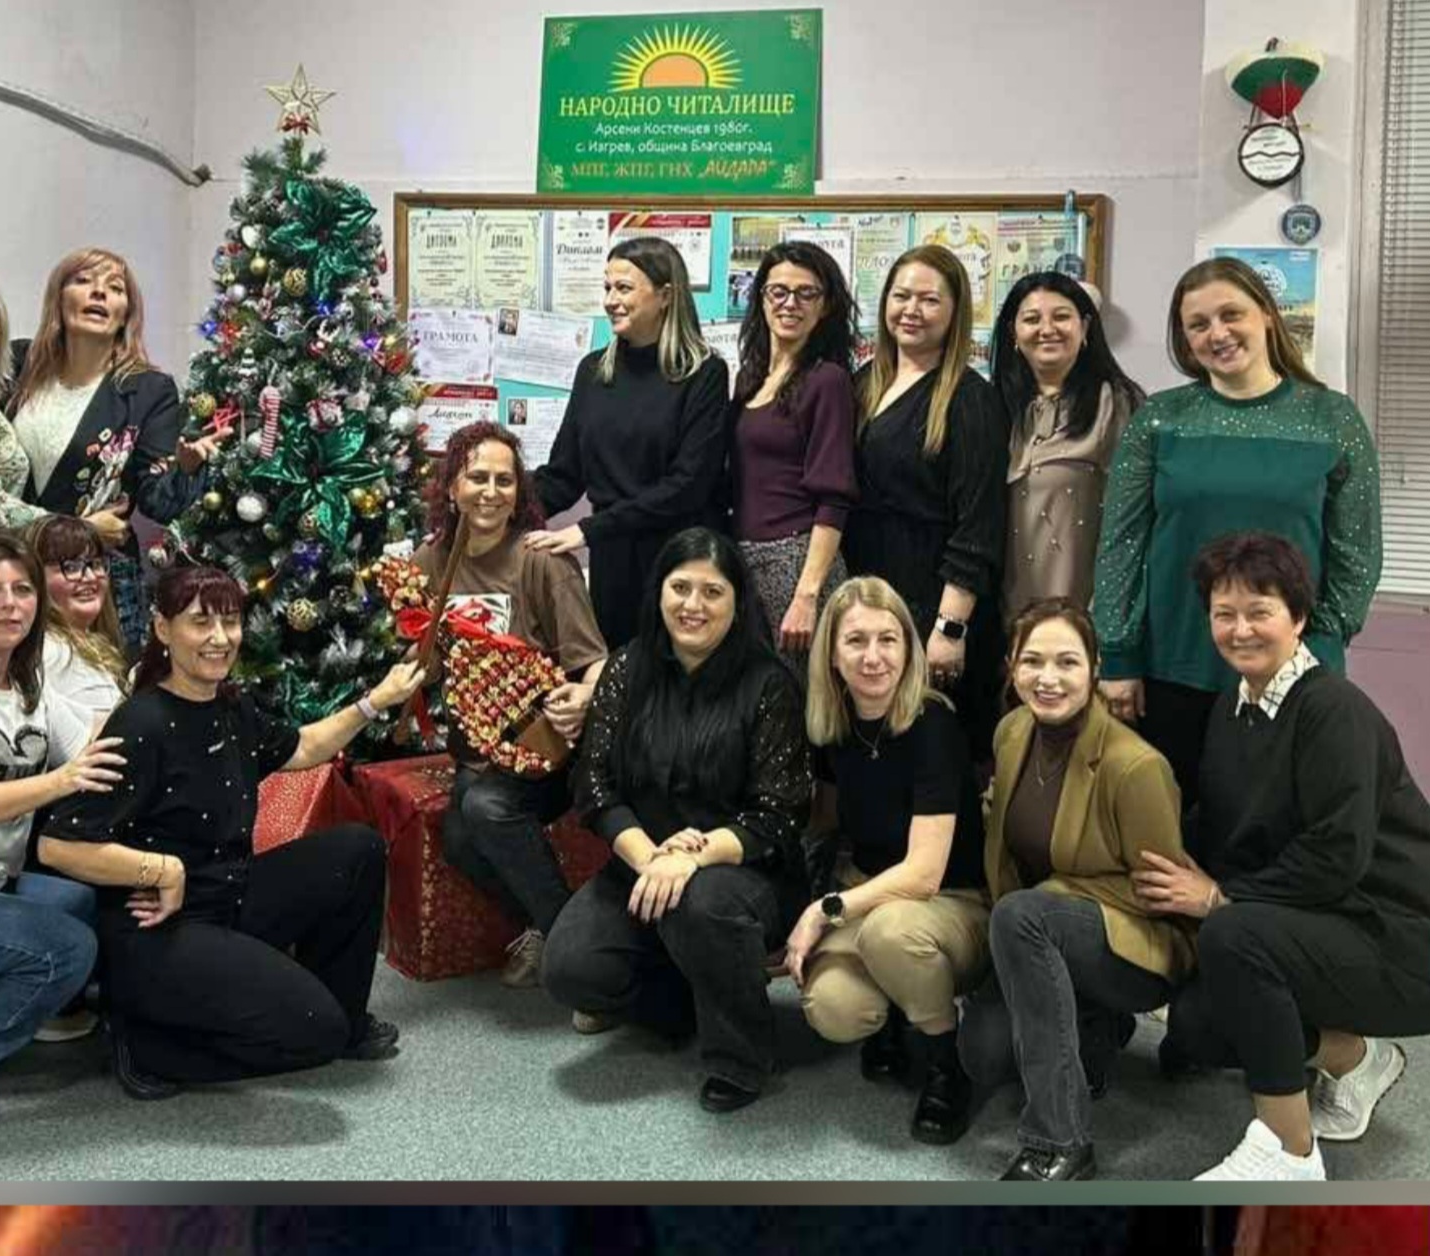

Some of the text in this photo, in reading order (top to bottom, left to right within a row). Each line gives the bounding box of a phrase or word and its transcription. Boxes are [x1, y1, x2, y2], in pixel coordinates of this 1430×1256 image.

[559, 94, 795, 119] НАРОДНО ЧИТАЛИЩЕ
[594, 120, 753, 138] Арсени Костенцев 1980г.
[588, 140, 635, 157] Изгрев,
[637, 140, 688, 154] община
[691, 139, 773, 155] Благоевград
[423, 330, 478, 343] ГРАМОТА
